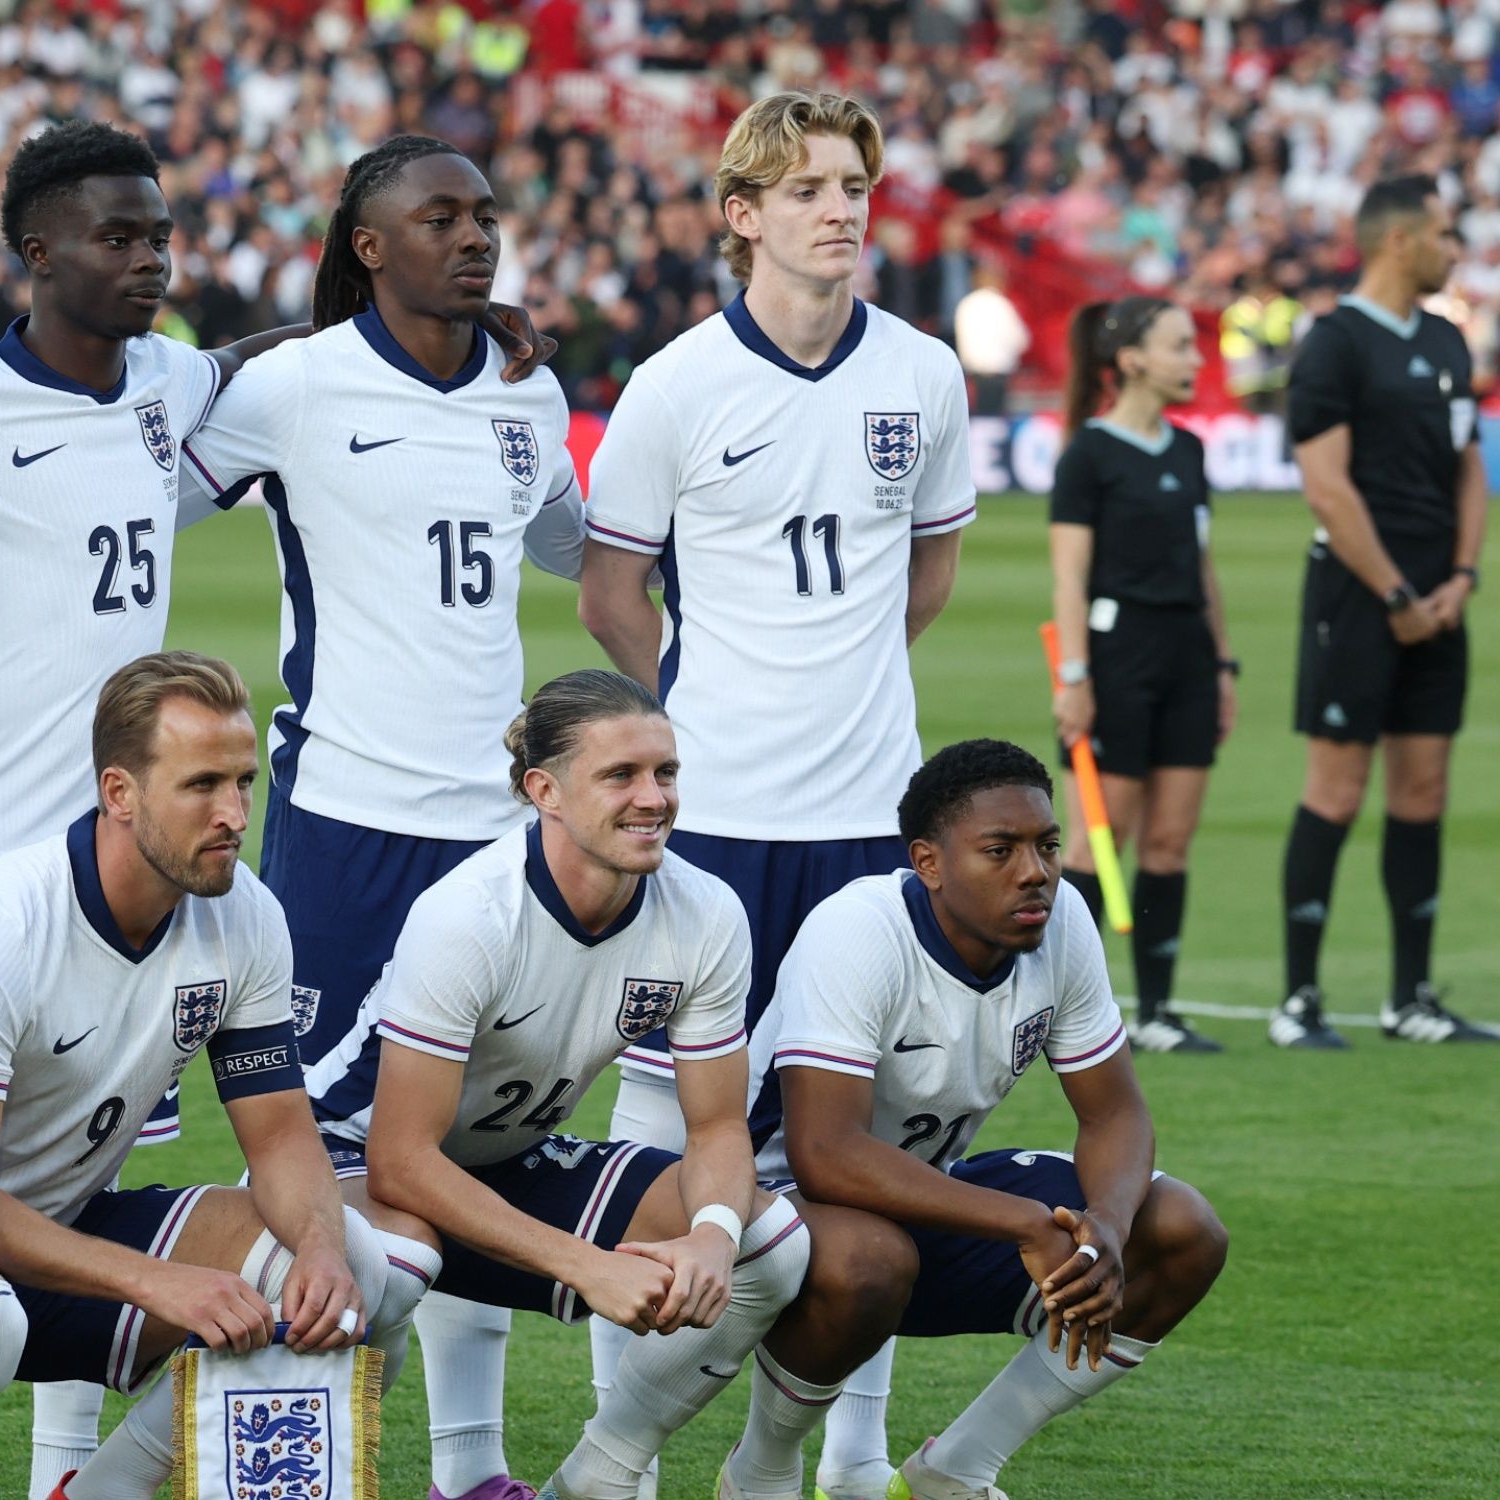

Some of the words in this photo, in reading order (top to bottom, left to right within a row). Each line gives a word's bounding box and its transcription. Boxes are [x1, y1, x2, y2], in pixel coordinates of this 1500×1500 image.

[874, 486, 906, 497] SENEGAL
[876, 498, 904, 510] 10.06.25
[88, 518, 157, 615] 25
[428, 520, 495, 608] 15
[782, 514, 845, 596] 11
[226, 1050, 288, 1073] RESPECT
[72, 1096, 125, 1168] 9
[469, 1078, 575, 1132] 24
[898, 1113, 972, 1166] 21
